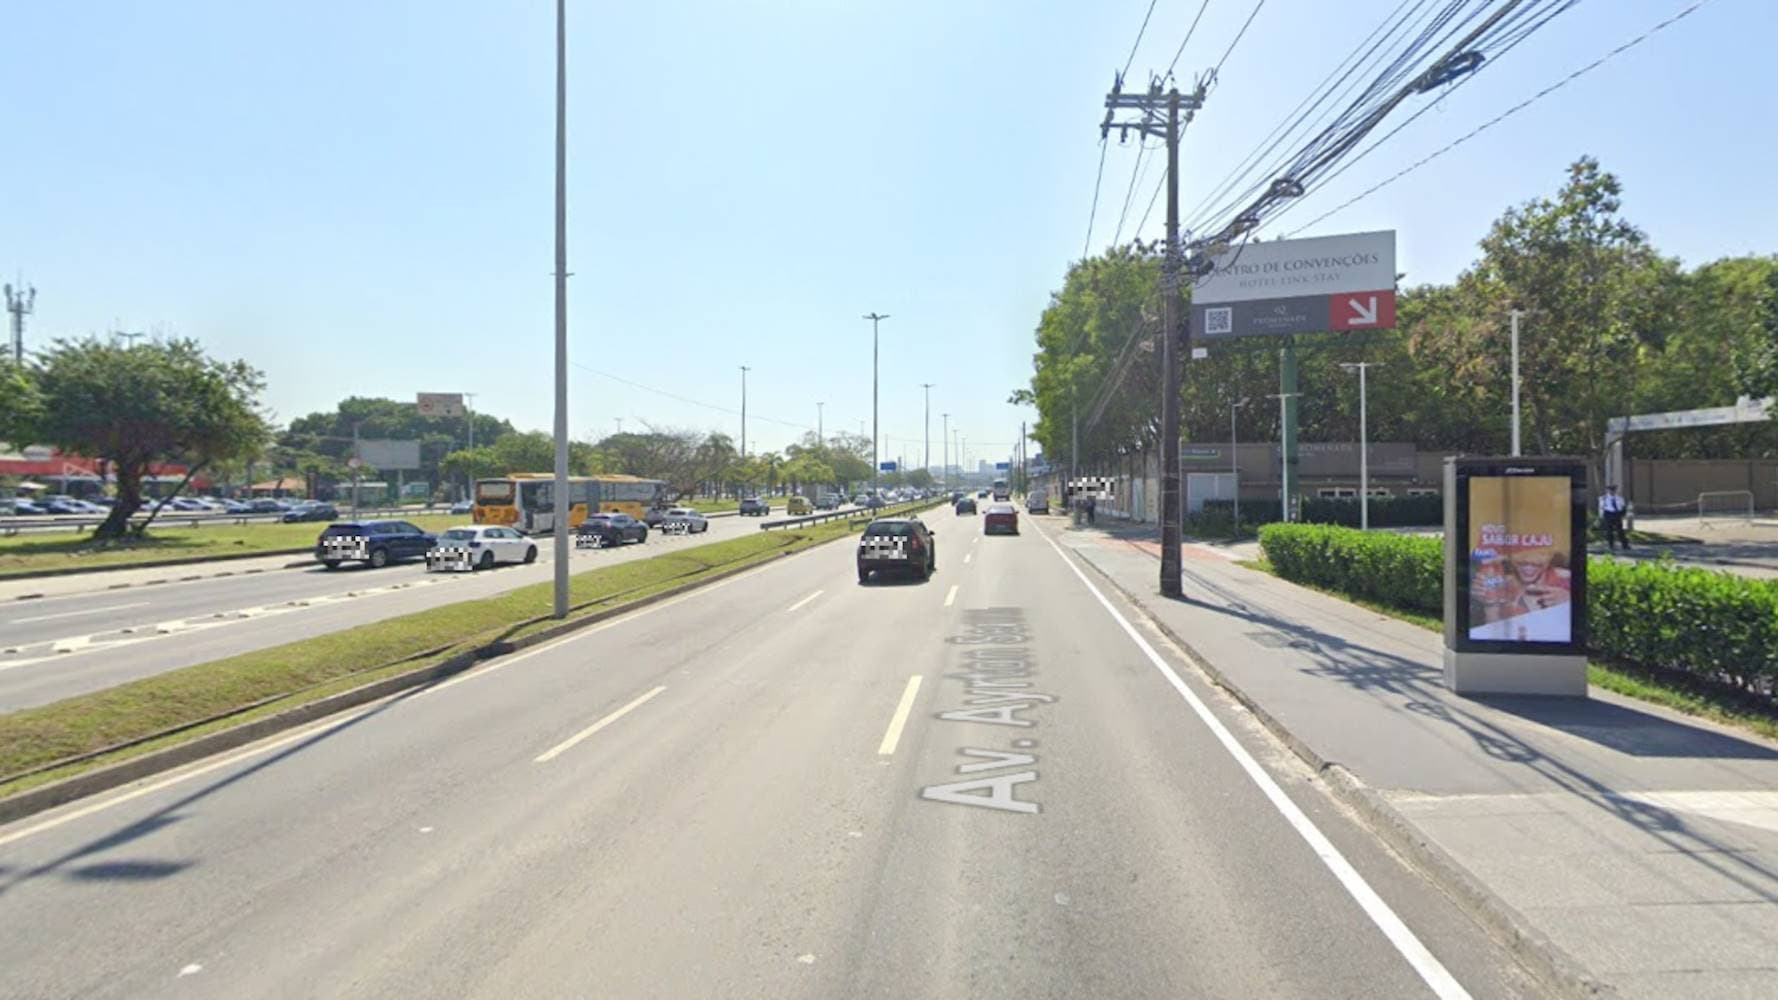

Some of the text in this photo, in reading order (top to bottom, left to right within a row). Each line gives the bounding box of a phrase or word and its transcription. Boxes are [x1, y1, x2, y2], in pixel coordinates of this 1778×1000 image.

[1212, 252, 1379, 278] ENTRO DE CONVENÇÕES
[1239, 272, 1342, 288] HOTEL LINK STAY
[1481, 532, 1553, 546] SABOR CAJU
